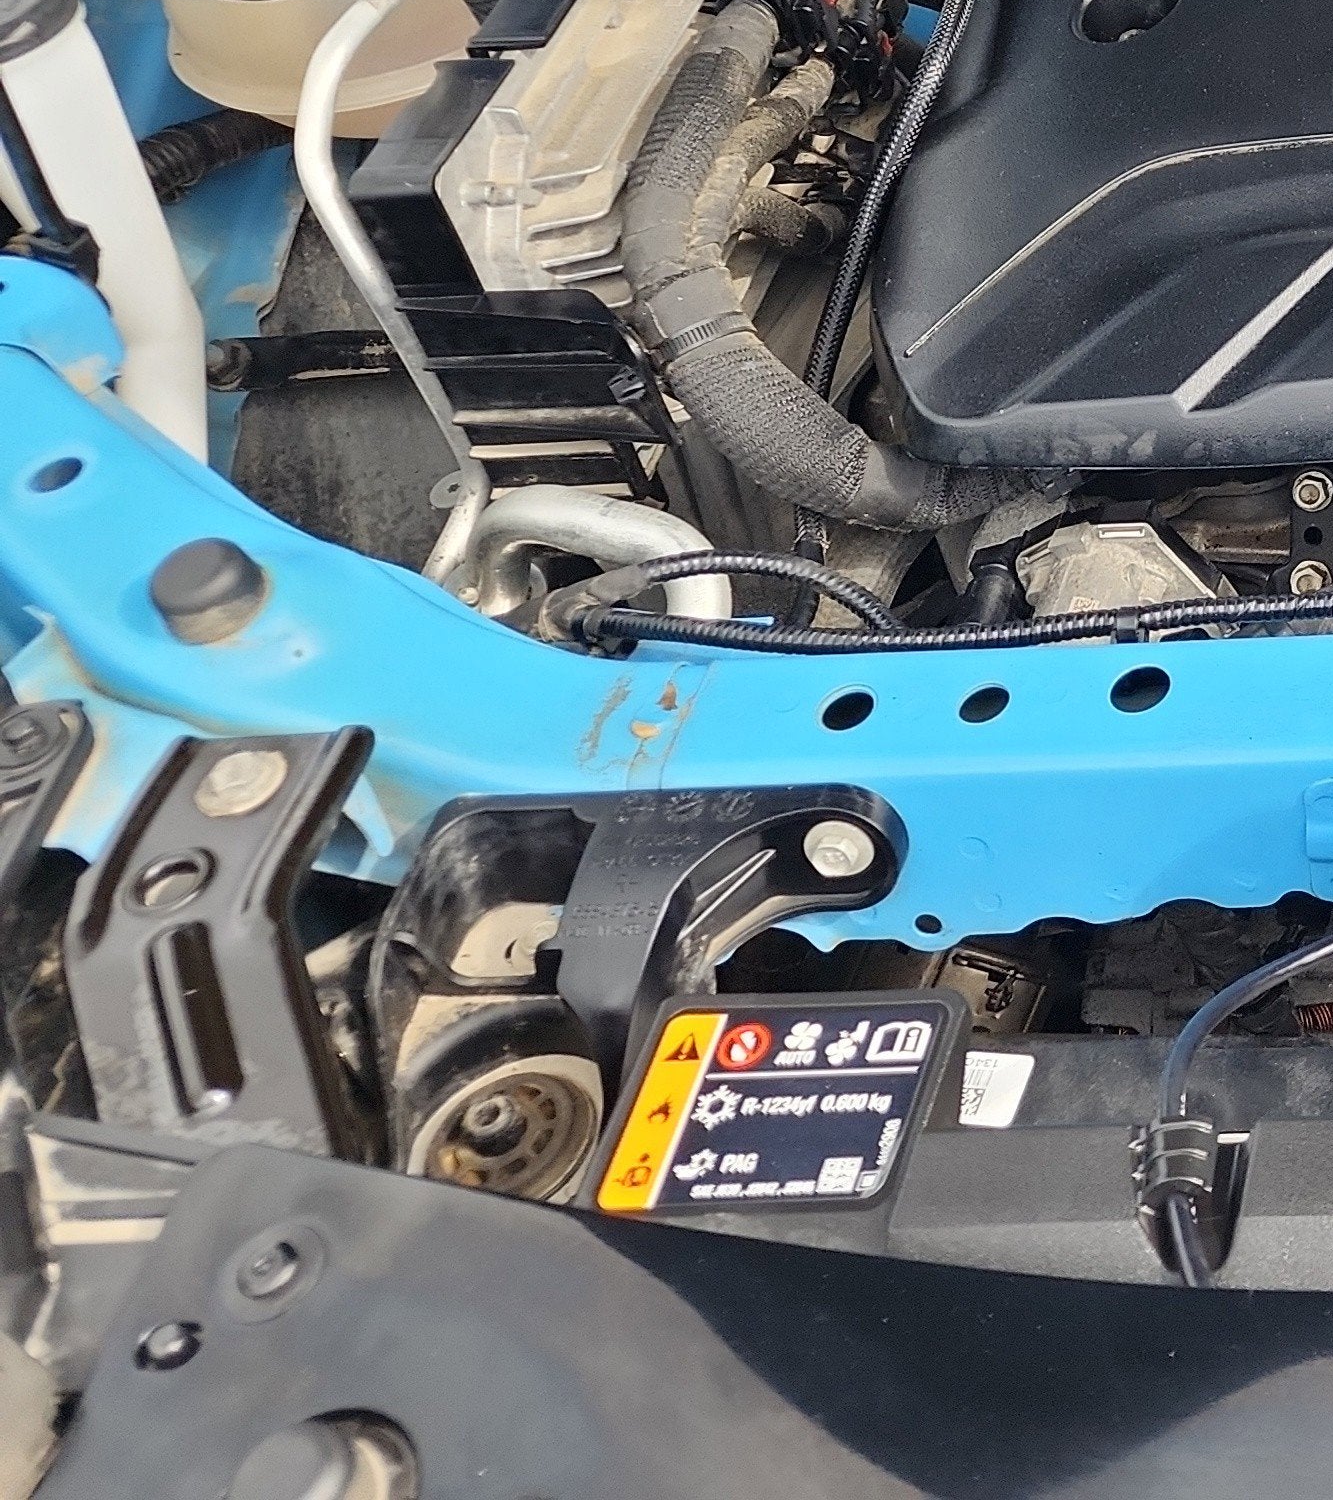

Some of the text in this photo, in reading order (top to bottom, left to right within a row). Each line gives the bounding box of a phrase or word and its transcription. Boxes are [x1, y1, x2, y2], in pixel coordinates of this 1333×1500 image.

[773, 1050, 817, 1067] AUTO
[869, 1093, 893, 1115] kg
[718, 1152, 760, 1174] PAG
